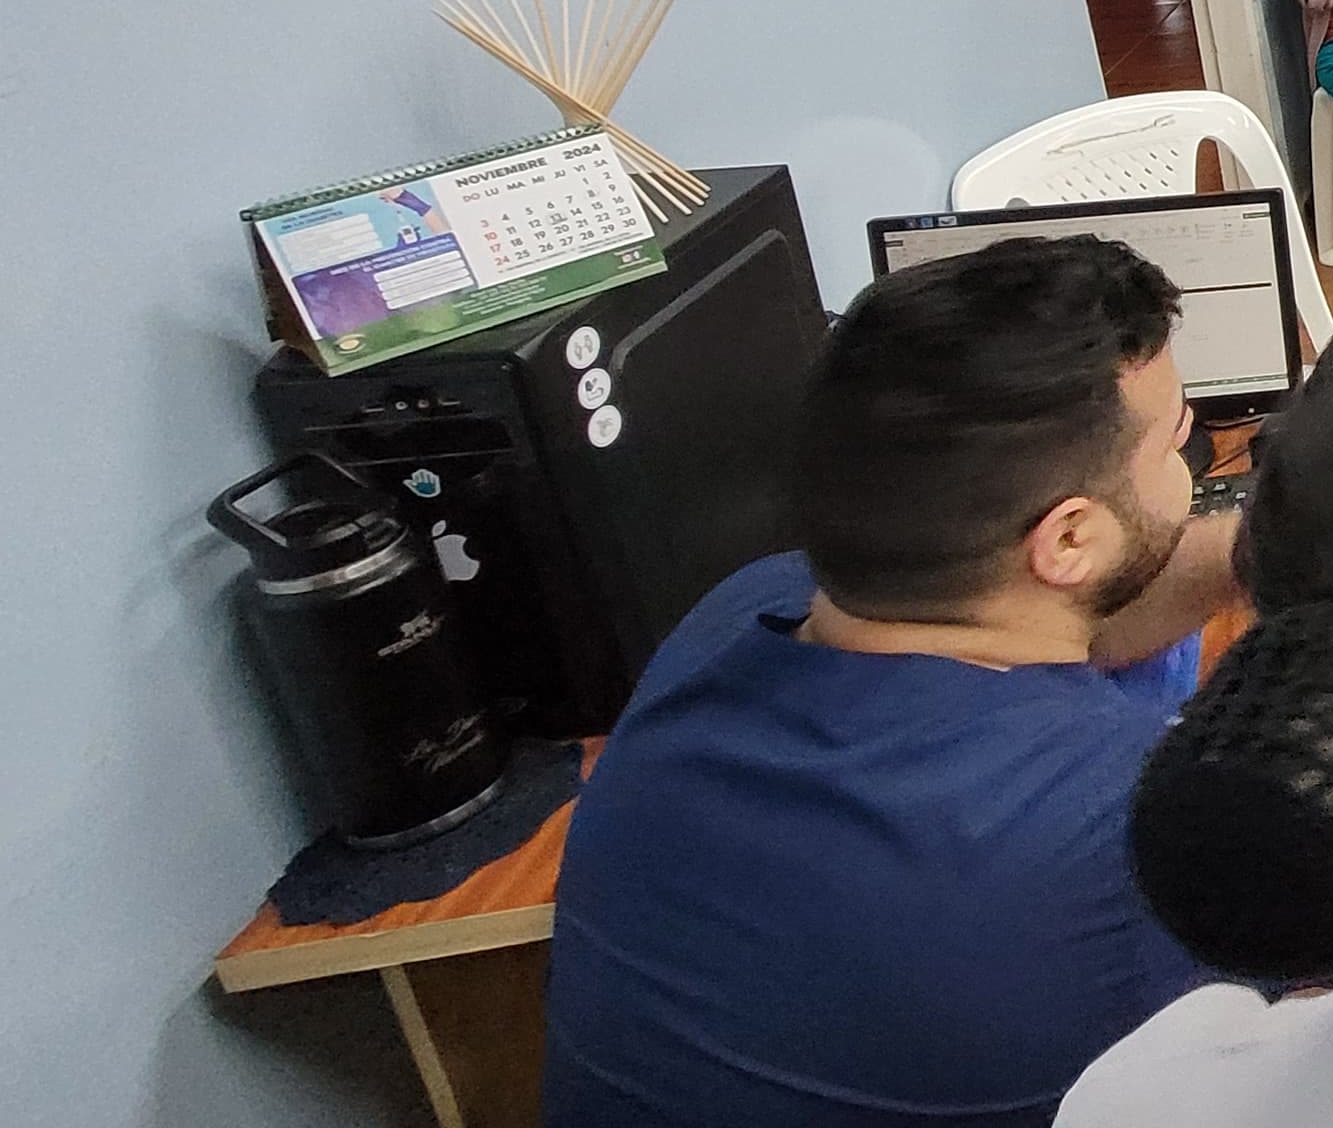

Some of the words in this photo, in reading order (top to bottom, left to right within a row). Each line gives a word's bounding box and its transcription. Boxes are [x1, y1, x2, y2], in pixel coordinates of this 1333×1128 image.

[455, 157, 548, 188] NOVIEMBRE
[563, 143, 602, 160] 2024
[463, 193, 481, 203] DO
[484, 188, 500, 197] LU
[506, 181, 526, 191] MA
[531, 175, 545, 185] MI
[553, 170, 567, 179] JU
[573, 164, 587, 173] VI
[593, 159, 609, 169] SA
[604, 171, 612, 180] 2
[484, 232, 498, 241] 10
[506, 227, 517, 236] 11
[528, 219, 542, 229] 12
[570, 208, 583, 217] 14
[591, 202, 603, 211] 15
[612, 196, 625, 205] 16
[501, 214, 511, 222] 4
[525, 207, 534, 216] 5
[547, 201, 555, 210] 6
[565, 195, 574, 204] 7
[608, 184, 617, 193] 9
[489, 244, 501, 254] 17
[510, 238, 523, 248] 18
[534, 231, 547, 241] 19
[554, 225, 570, 234] 20
[576, 219, 589, 228] 21
[595, 213, 611, 223] 22
[616, 207, 632, 216] 23
[495, 256, 511, 266] 24
[515, 250, 531, 260] 25
[538, 244, 554, 254] 26
[559, 237, 574, 247] 27
[579, 231, 595, 241] 28
[600, 224, 615, 234] 29
[622, 218, 637, 228] 30
